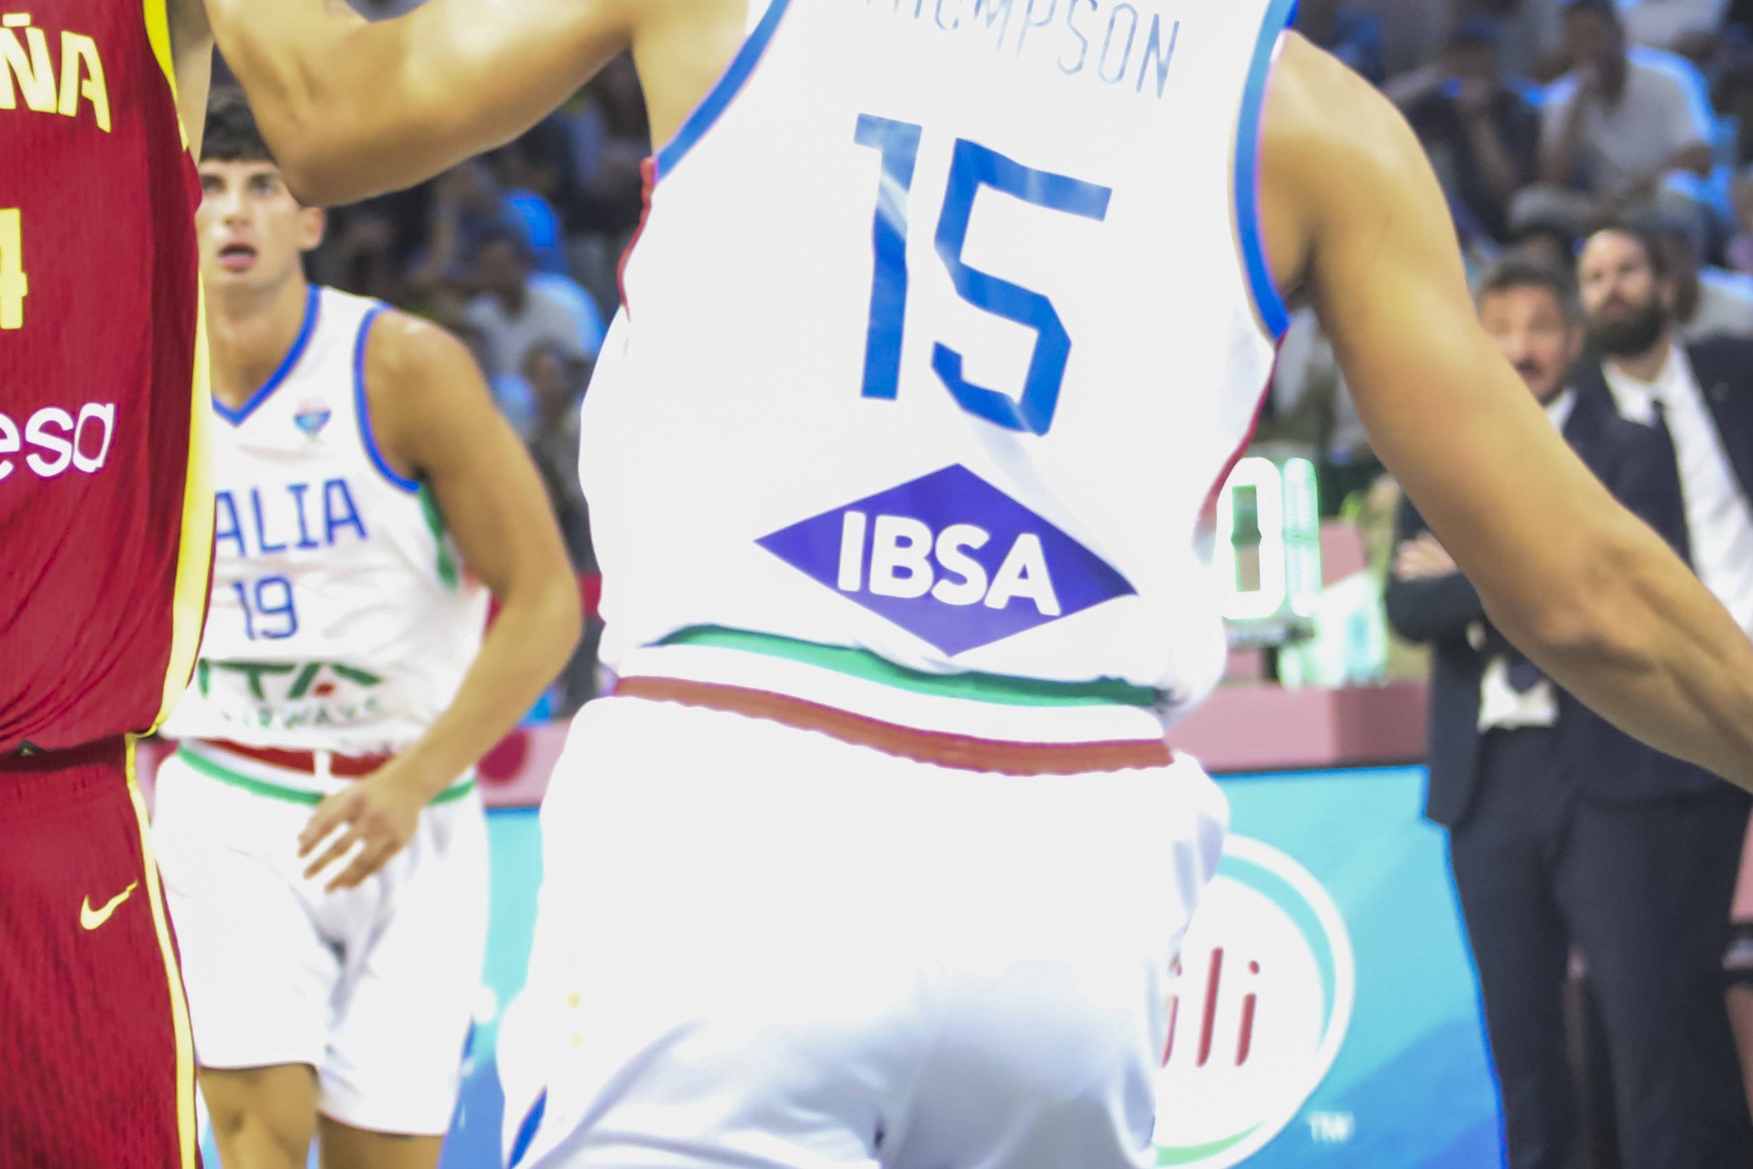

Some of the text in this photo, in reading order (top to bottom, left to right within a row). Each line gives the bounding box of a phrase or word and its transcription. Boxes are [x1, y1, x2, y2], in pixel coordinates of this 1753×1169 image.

[853, 113, 1113, 438] 15
[215, 477, 369, 558] ALIA
[837, 509, 1063, 617] IBSA
[231, 575, 299, 642] 19
